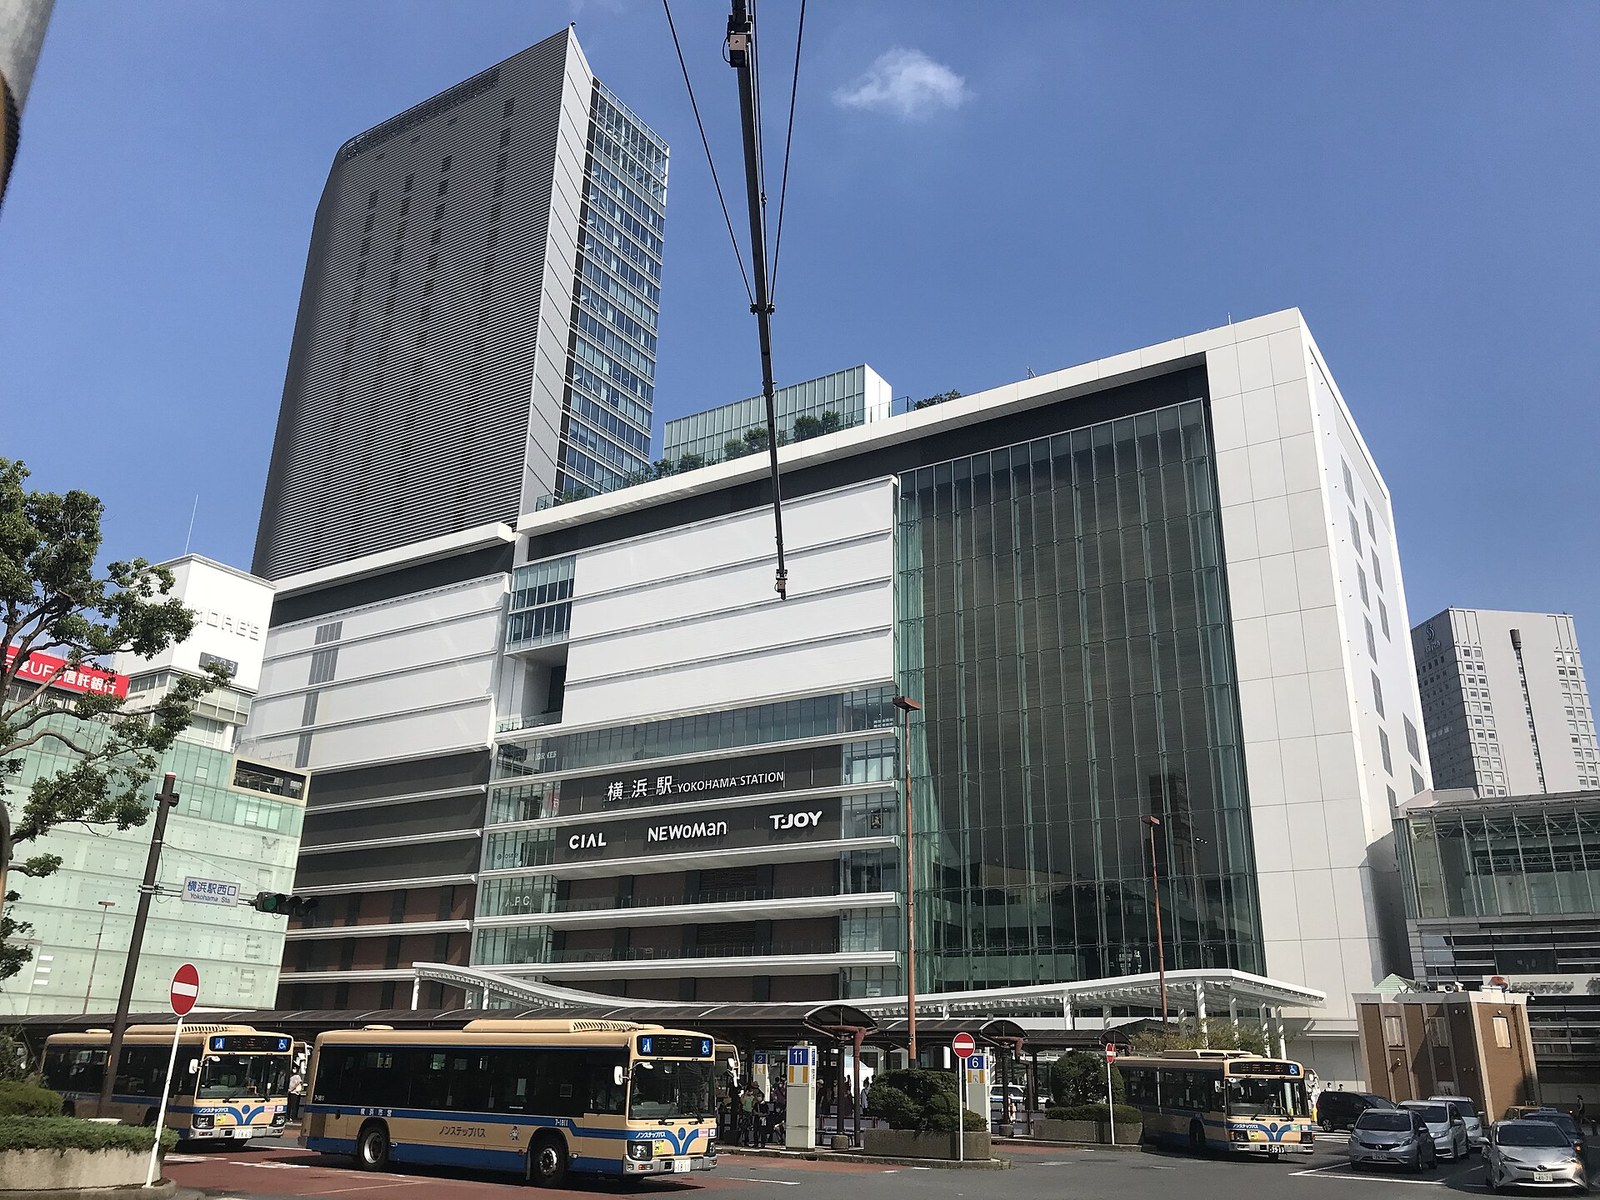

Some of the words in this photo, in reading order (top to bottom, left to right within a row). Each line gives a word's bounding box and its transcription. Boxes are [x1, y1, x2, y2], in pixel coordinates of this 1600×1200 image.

[196, 607, 261, 641] ORE'S
[607, 775, 673, 802] 横浜駅
[677, 776, 737, 794] YOKOHAMA
[740, 771, 784, 787] STATION
[569, 832, 607, 850] CIAL
[187, 880, 237, 897] 横浜駅西口
[190, 892, 219, 902] Yokohama
[757, 1055, 763, 1064] 2
[793, 1050, 803, 1064] 11
[972, 1056, 979, 1068] 6
[439, 1125, 486, 1138] ノンステップバス
